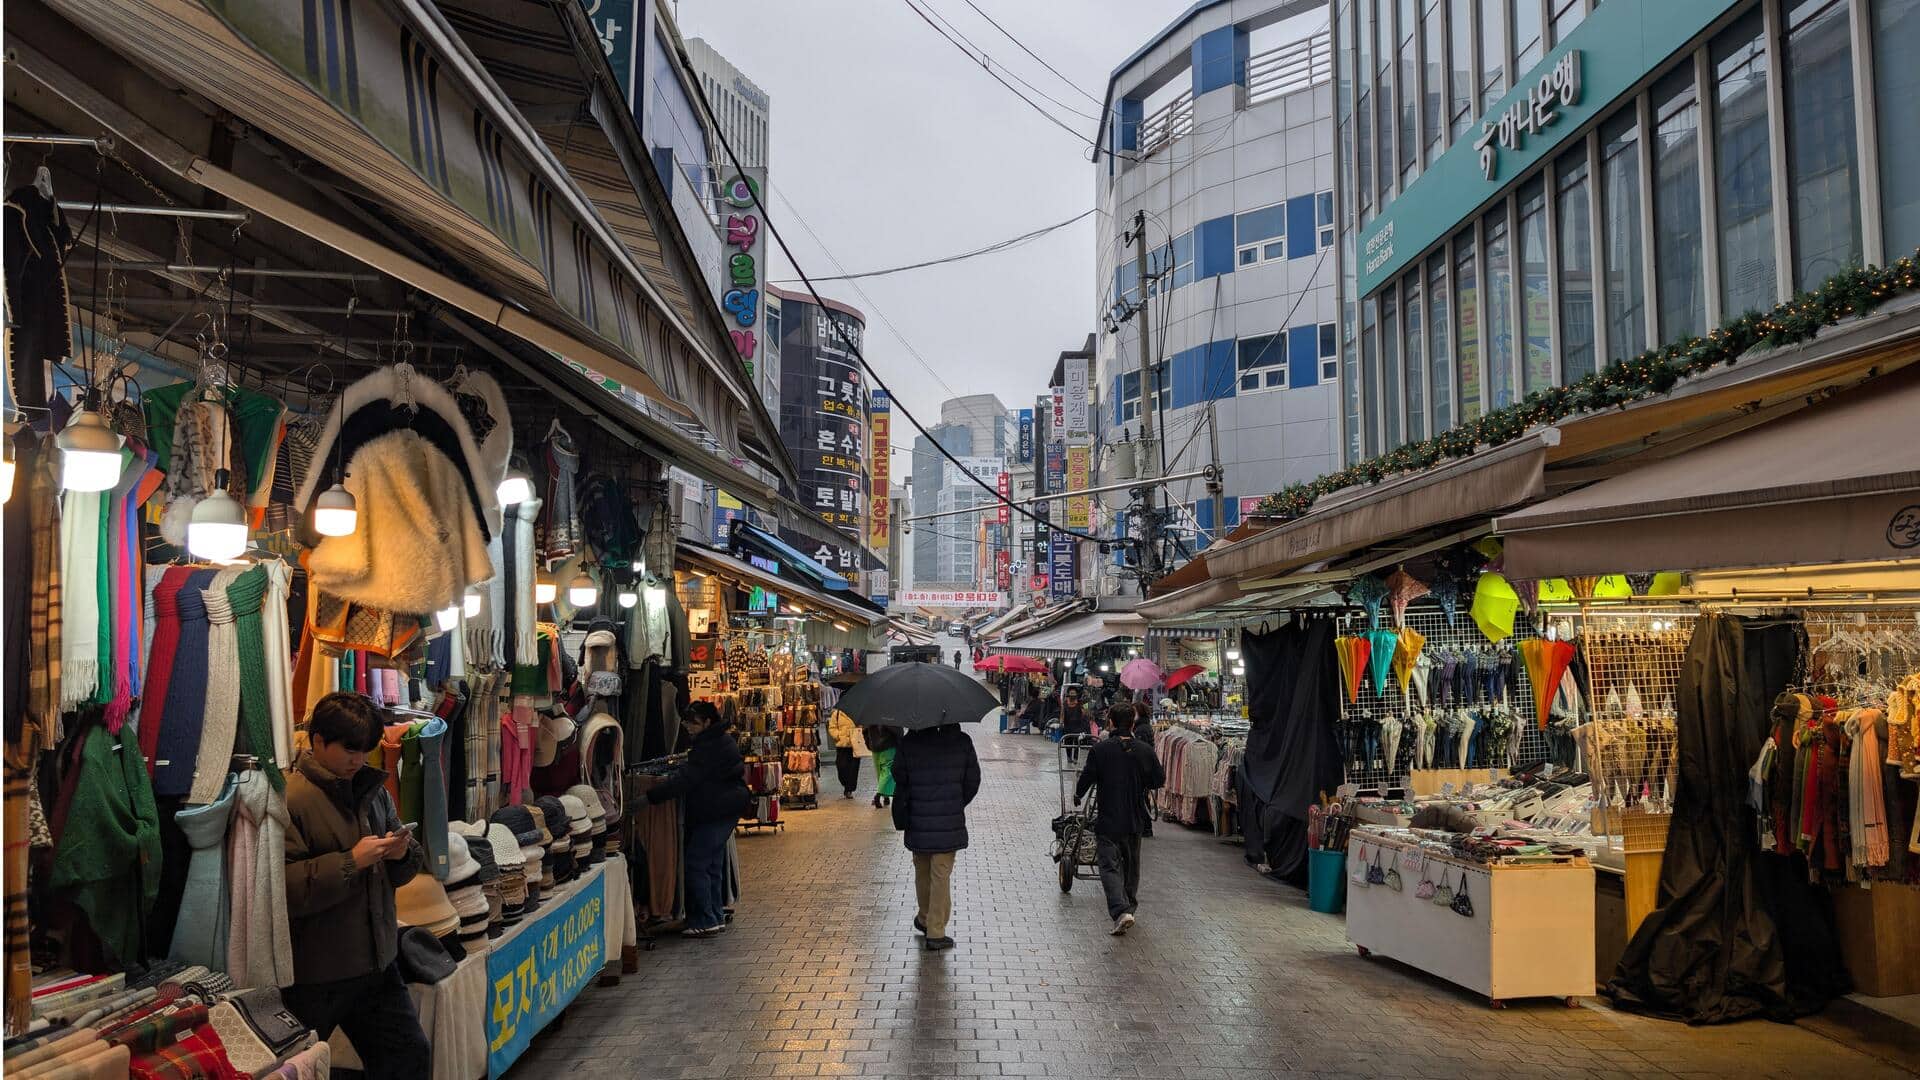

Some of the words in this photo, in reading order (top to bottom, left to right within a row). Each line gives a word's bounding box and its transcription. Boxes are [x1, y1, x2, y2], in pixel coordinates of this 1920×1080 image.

[1498, 48, 1581, 151] 하나은행
[1022, 424, 1030, 458] 우리은행
[1053, 395, 1065, 428] 부동산
[873, 418, 888, 538] 그릇도매상가
[1053, 543, 1073, 594] 그릇도매
[491, 944, 539, 1054] 모자
